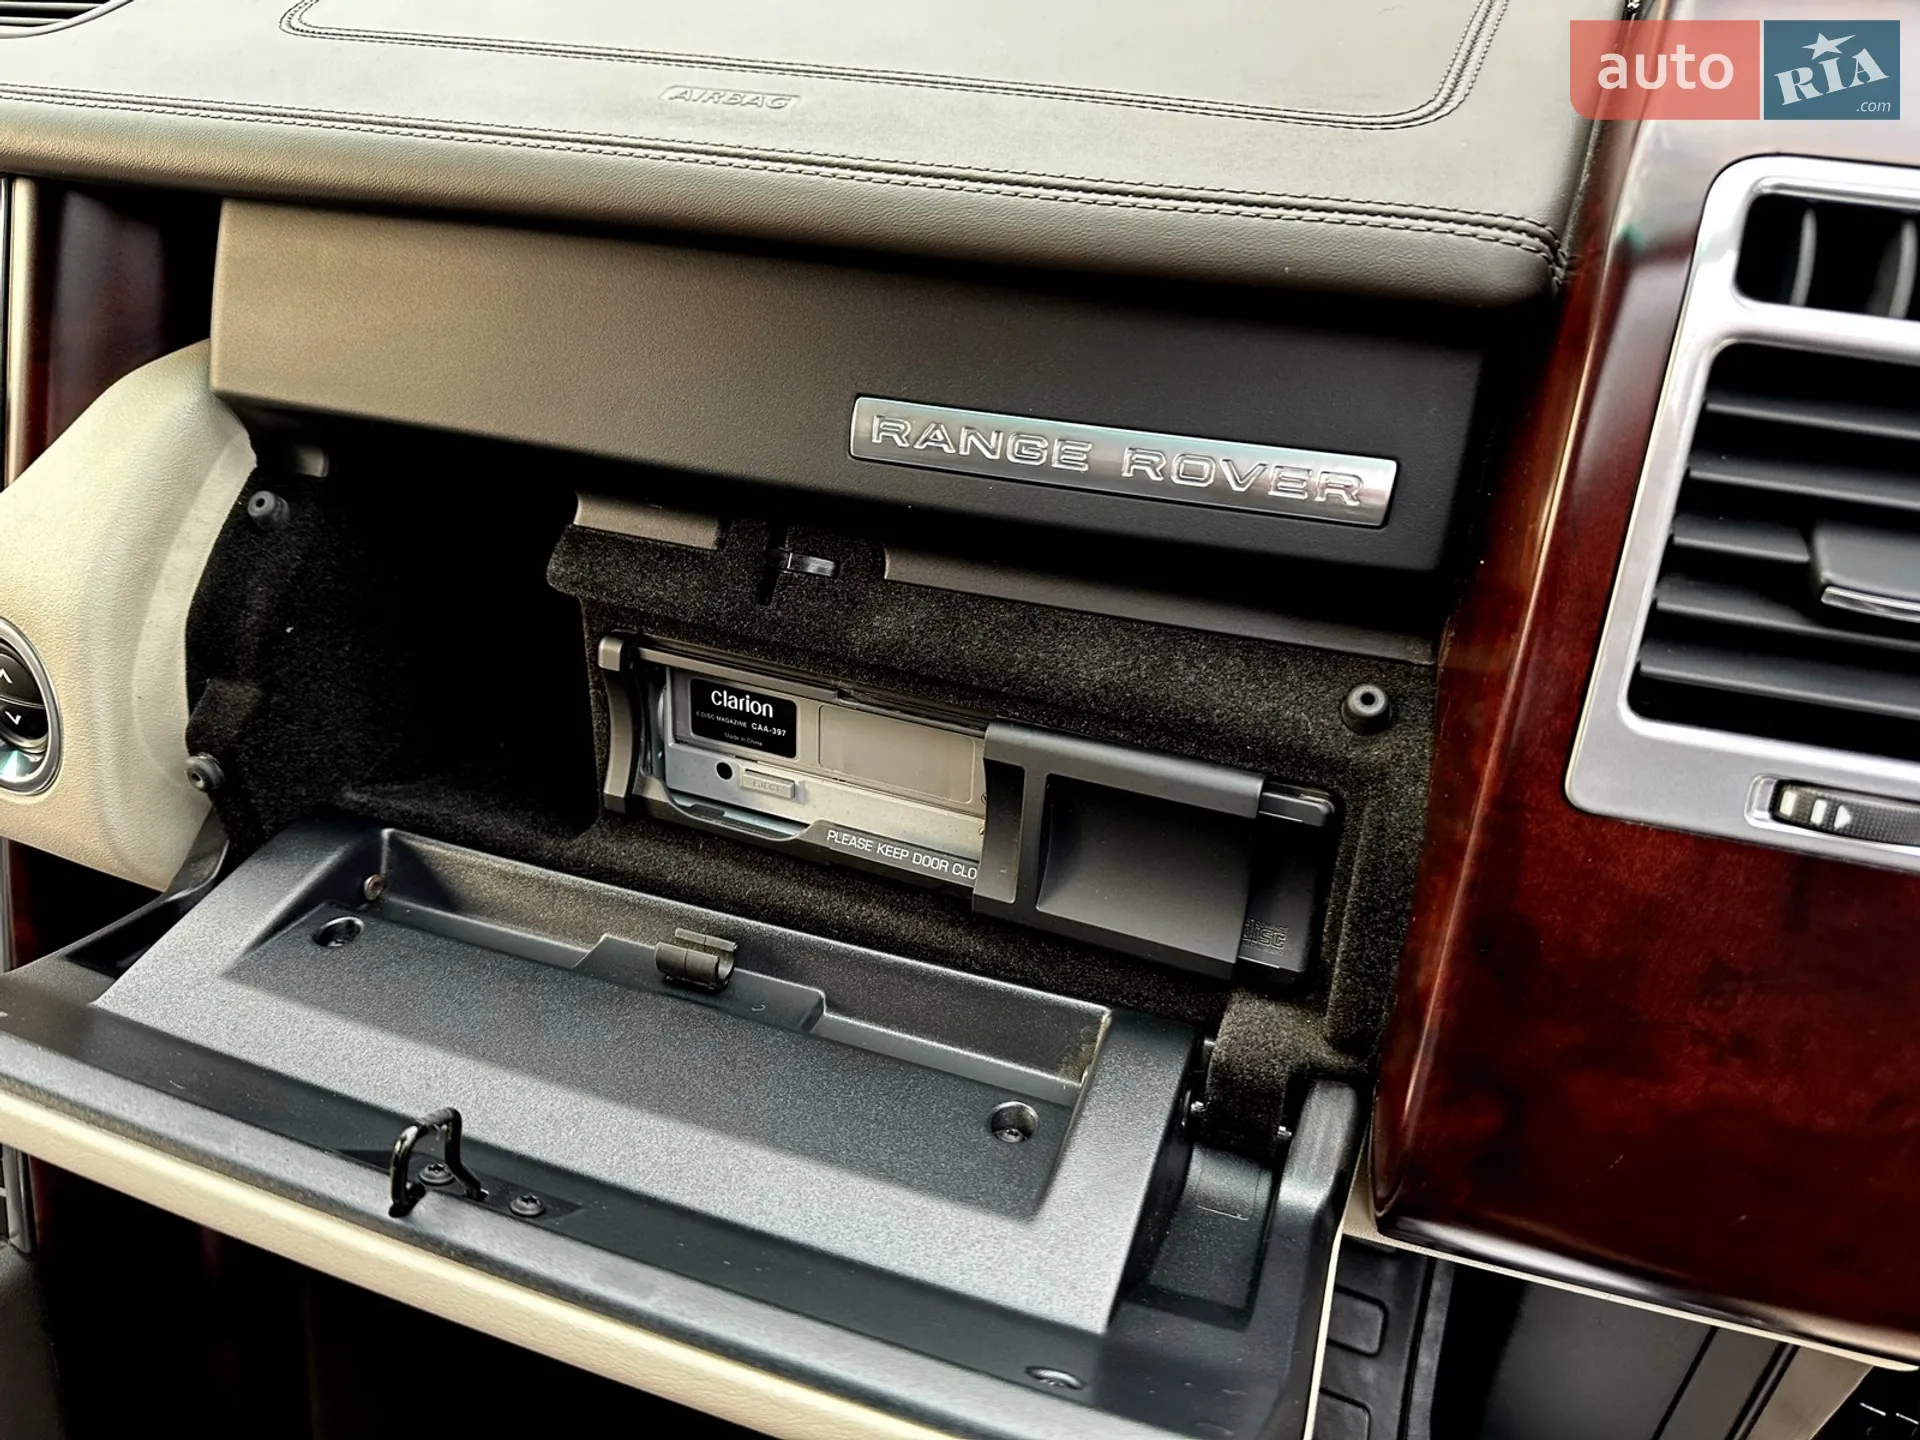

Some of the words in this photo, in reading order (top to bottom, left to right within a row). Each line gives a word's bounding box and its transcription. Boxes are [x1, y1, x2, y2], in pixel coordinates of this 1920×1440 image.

[667, 89, 792, 110] AIRBAG
[870, 414, 1093, 473] RANGE
[1121, 446, 1365, 507] ROVER
[716, 715, 748, 729] MAGAZINE
[751, 722, 787, 737] CAA-397
[753, 779, 781, 793] EJECT
[827, 829, 874, 852] PLEASE
[876, 842, 909, 861] KEEP
[912, 853, 950, 873] DOOR
